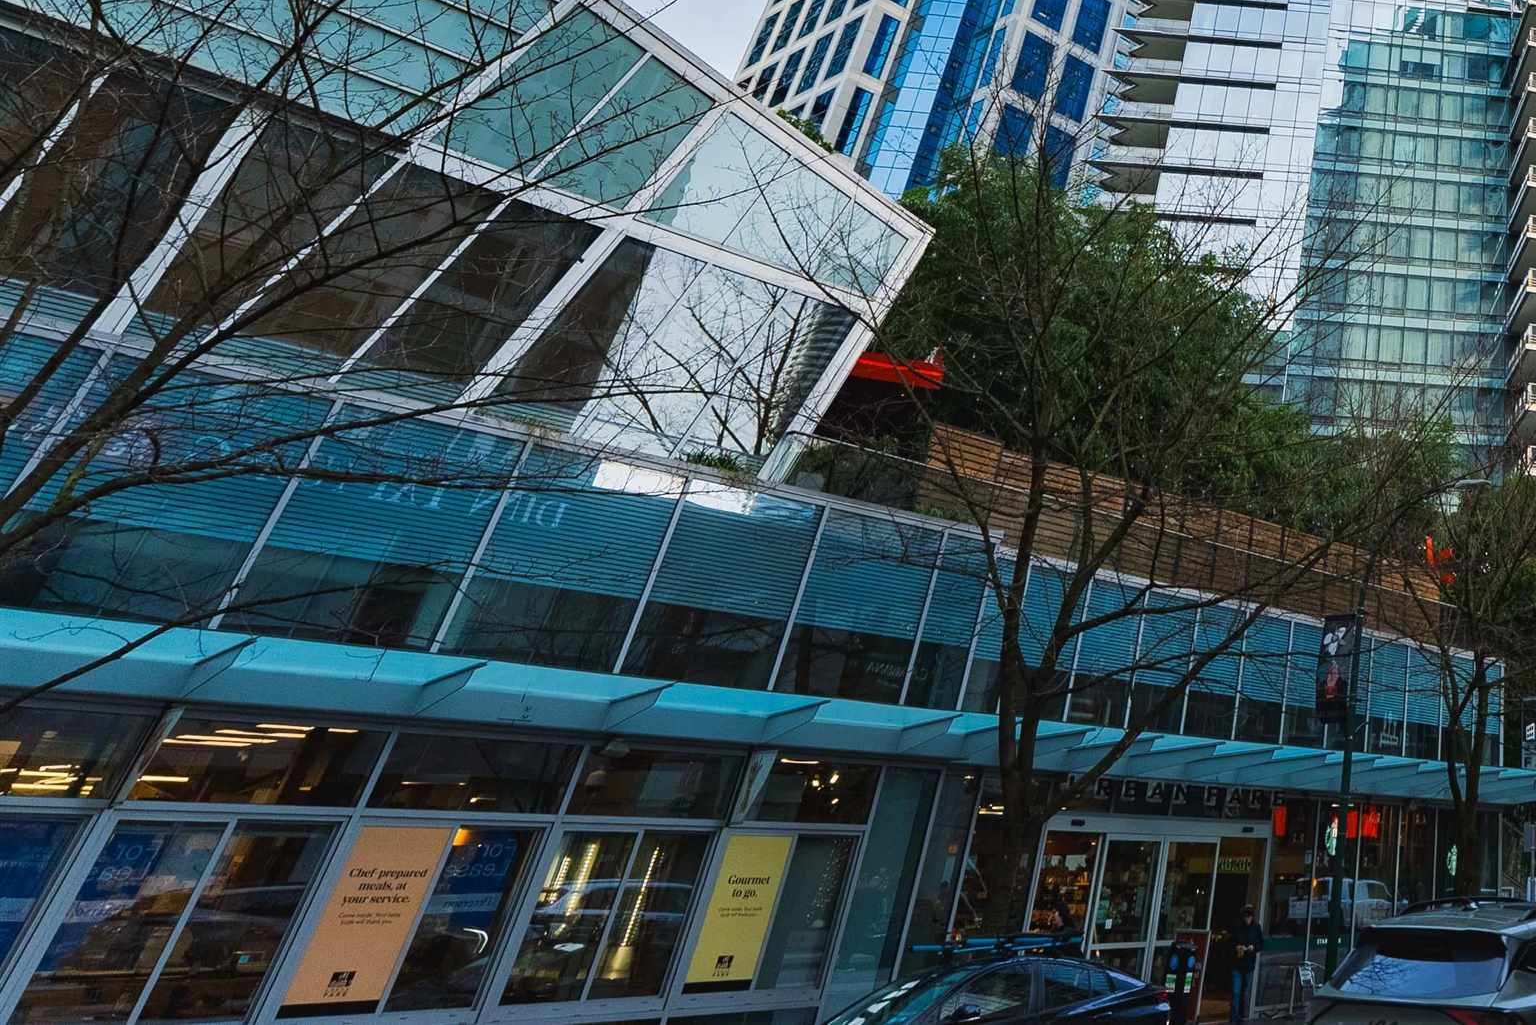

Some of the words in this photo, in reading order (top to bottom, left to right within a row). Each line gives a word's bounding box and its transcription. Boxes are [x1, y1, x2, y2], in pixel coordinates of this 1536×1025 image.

[1066, 773, 1189, 805] RBAN
[728, 875, 771, 885] Gourmet
[358, 881, 392, 891] meals,
[395, 882, 407, 890] at
[732, 889, 742, 897] to
[743, 889, 758, 899] go.
[341, 896, 368, 906] your
[370, 894, 410, 904] service.
